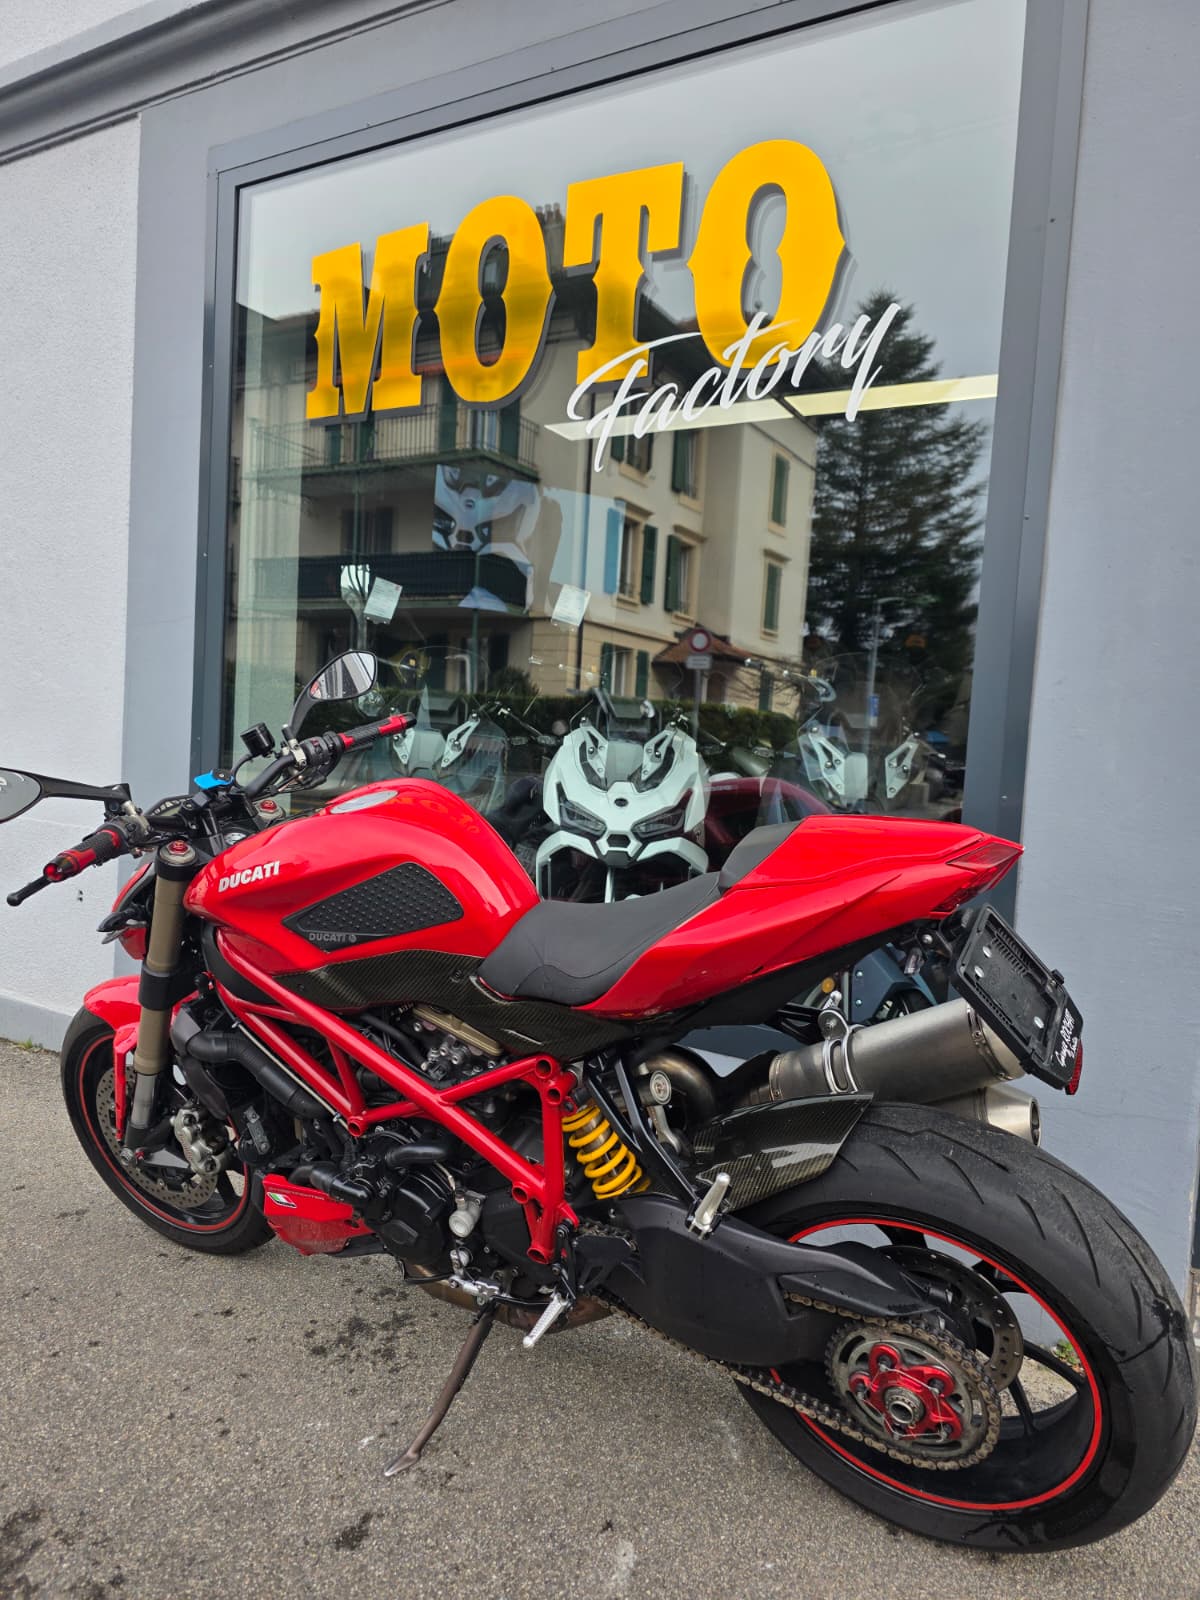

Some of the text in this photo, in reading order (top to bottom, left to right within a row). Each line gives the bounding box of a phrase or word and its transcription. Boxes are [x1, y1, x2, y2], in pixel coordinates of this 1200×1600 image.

[305, 138, 847, 421] MOTO
[565, 302, 901, 473] Factory
[217, 860, 281, 893] DUCATI
[308, 932, 347, 943] DUCATI
